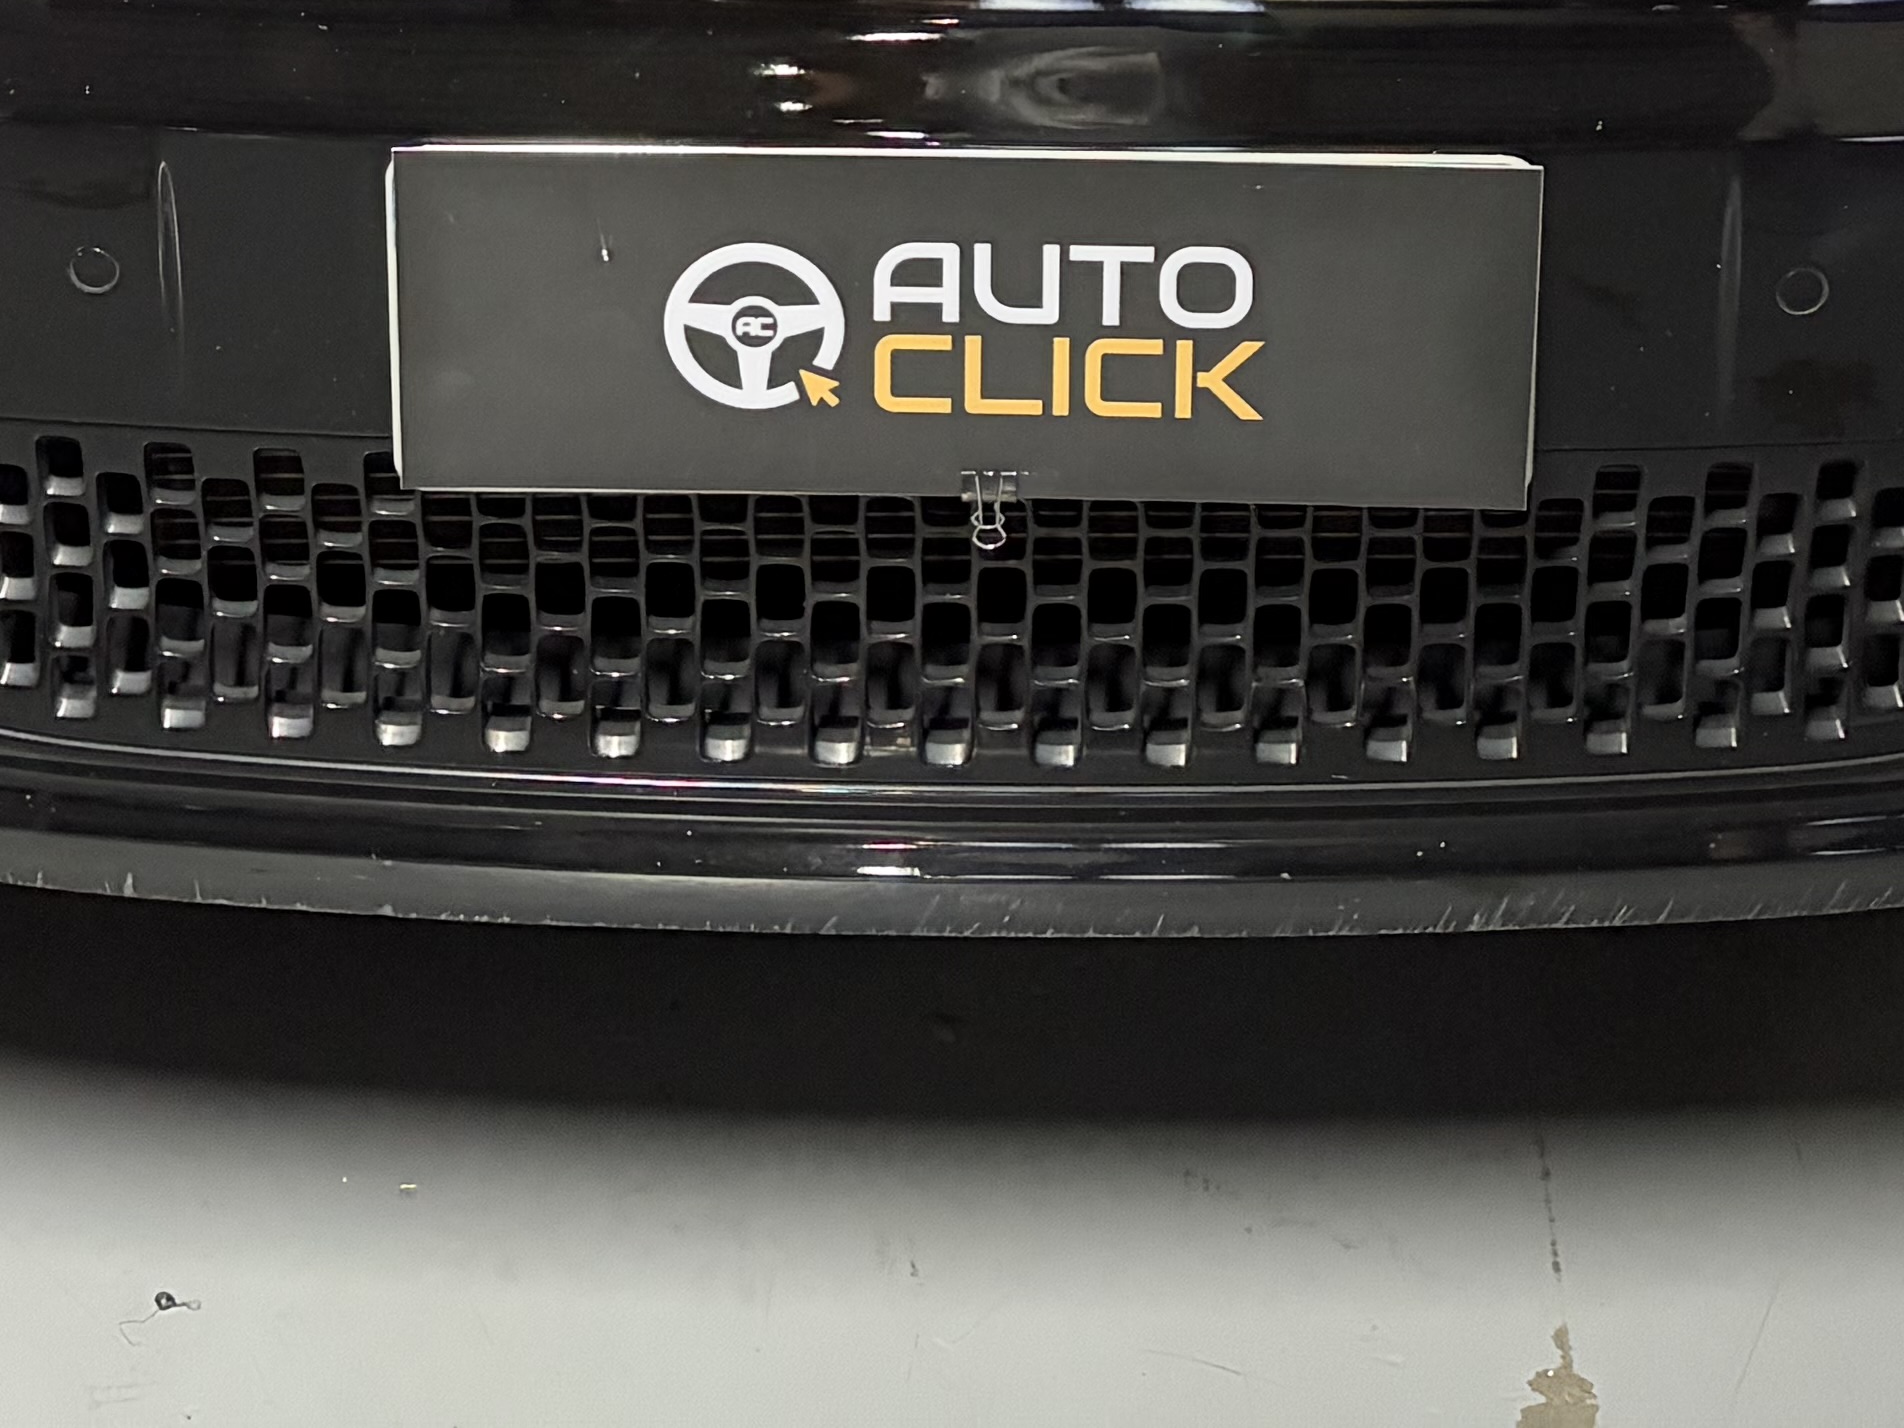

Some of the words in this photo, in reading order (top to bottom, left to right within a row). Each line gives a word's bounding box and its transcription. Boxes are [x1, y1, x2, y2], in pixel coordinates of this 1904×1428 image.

[735, 316, 775, 337] AC
[873, 242, 1254, 329] AUTO
[873, 334, 1265, 421] CLICK
